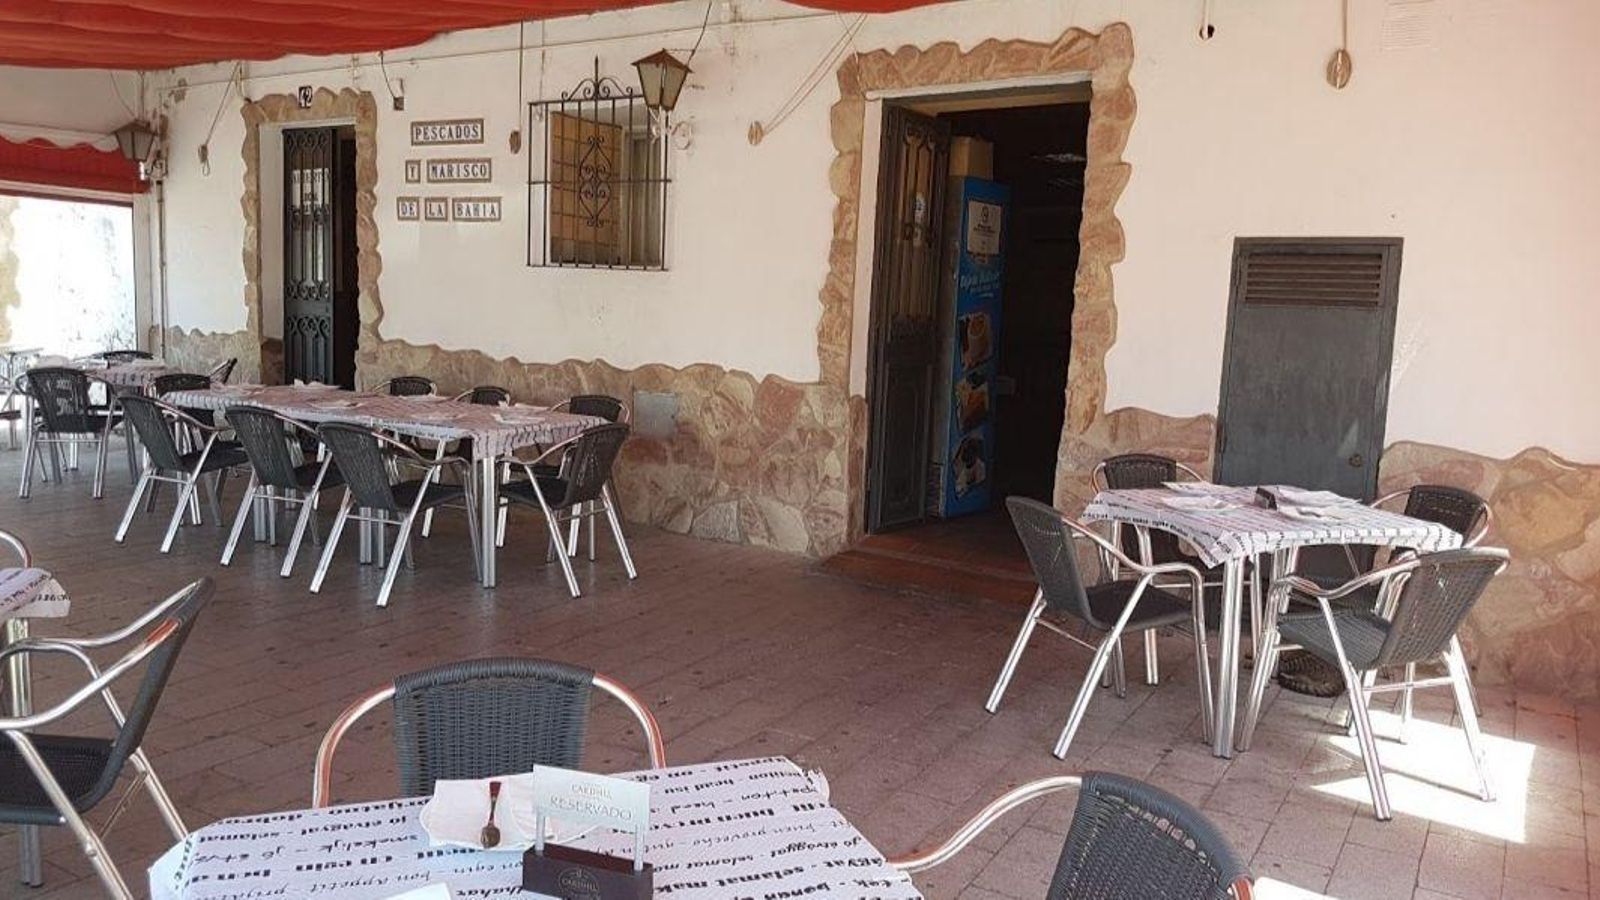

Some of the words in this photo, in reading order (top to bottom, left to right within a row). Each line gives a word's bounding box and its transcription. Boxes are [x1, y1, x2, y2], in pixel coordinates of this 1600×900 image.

[415, 125, 479, 140] PESCADOS
[432, 164, 487, 178] MARISCO
[401, 203, 415, 216] DE
[429, 203, 443, 217] LA
[551, 795, 632, 820] RESERVADO
